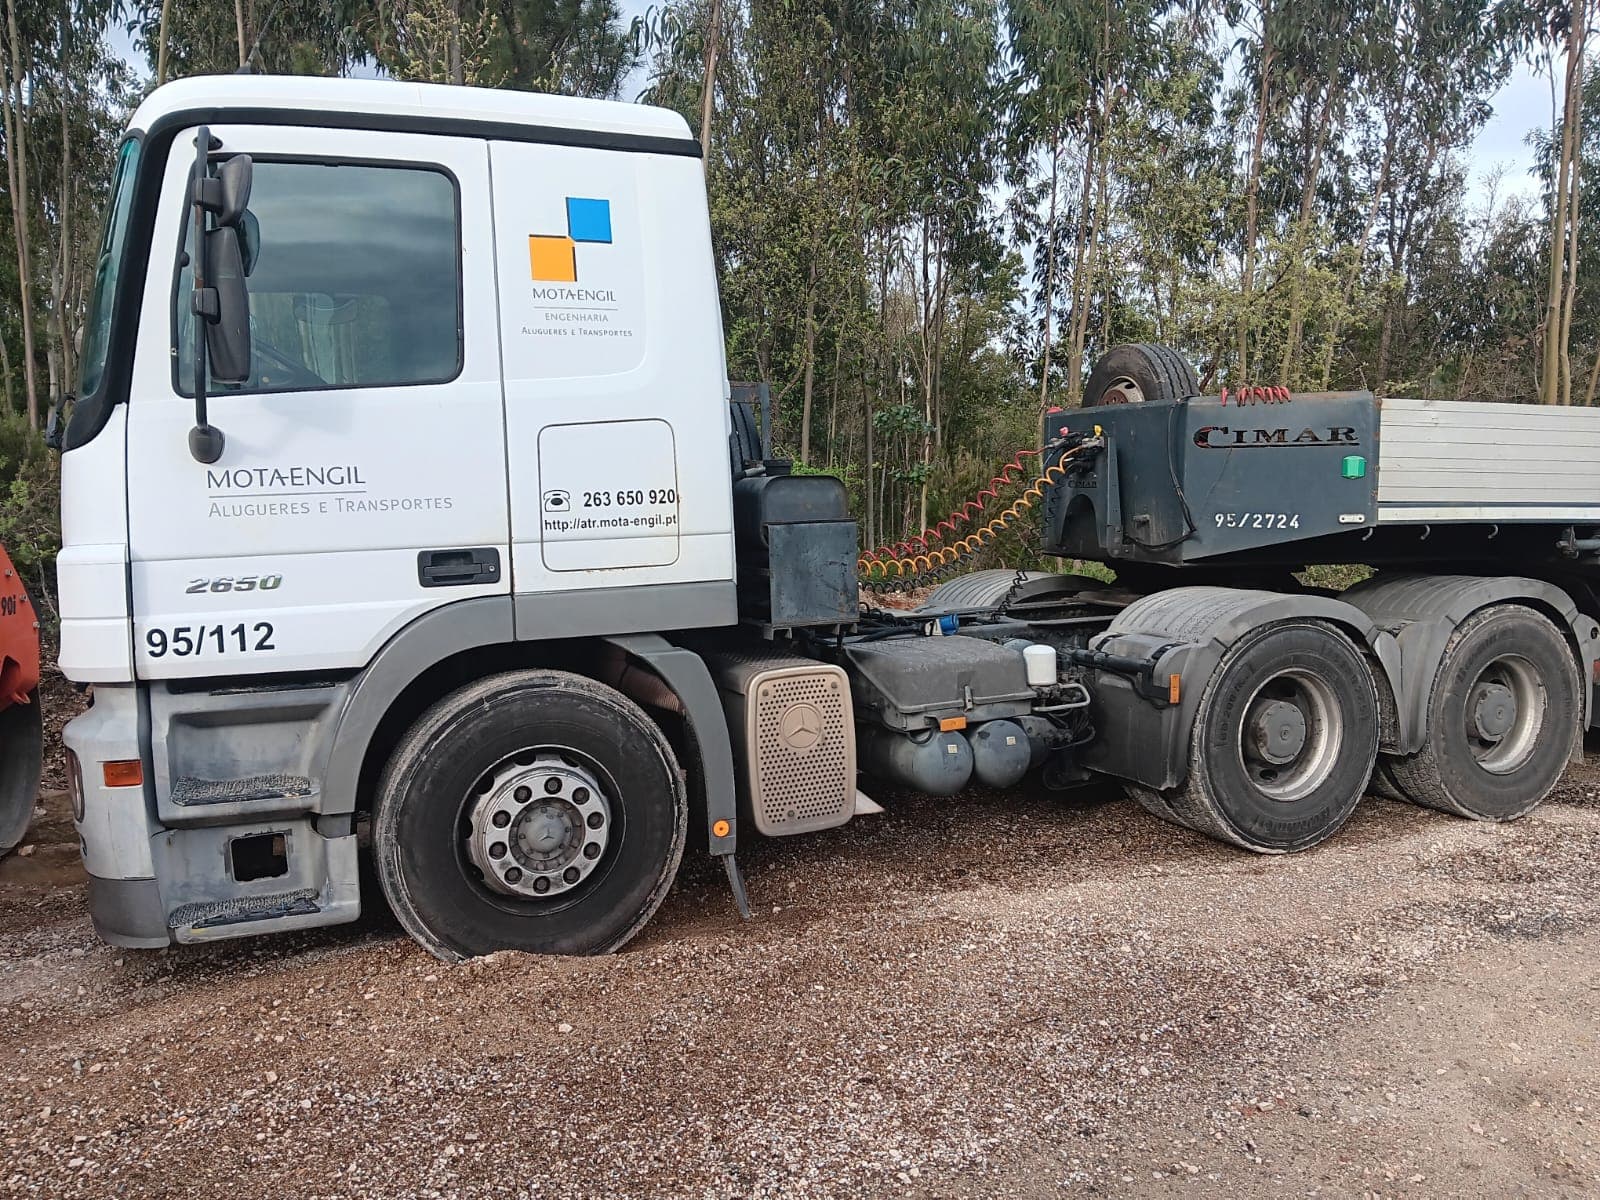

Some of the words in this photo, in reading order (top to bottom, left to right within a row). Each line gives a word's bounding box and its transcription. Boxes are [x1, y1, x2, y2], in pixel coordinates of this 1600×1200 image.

[533, 288, 616, 302] MOTA-ENGIL
[545, 312, 608, 322] ENGENHARIA
[207, 466, 366, 488] MOTA-ENGIL
[583, 491, 612, 507] 263
[616, 490, 644, 506] 650
[649, 489, 676, 504] 920
[544, 513, 678, 532] http://atr.mota-engil.pt
[1214, 513, 1300, 529] 95/2724
[185, 574, 282, 594] 2650
[146, 621, 275, 658] 95/112
